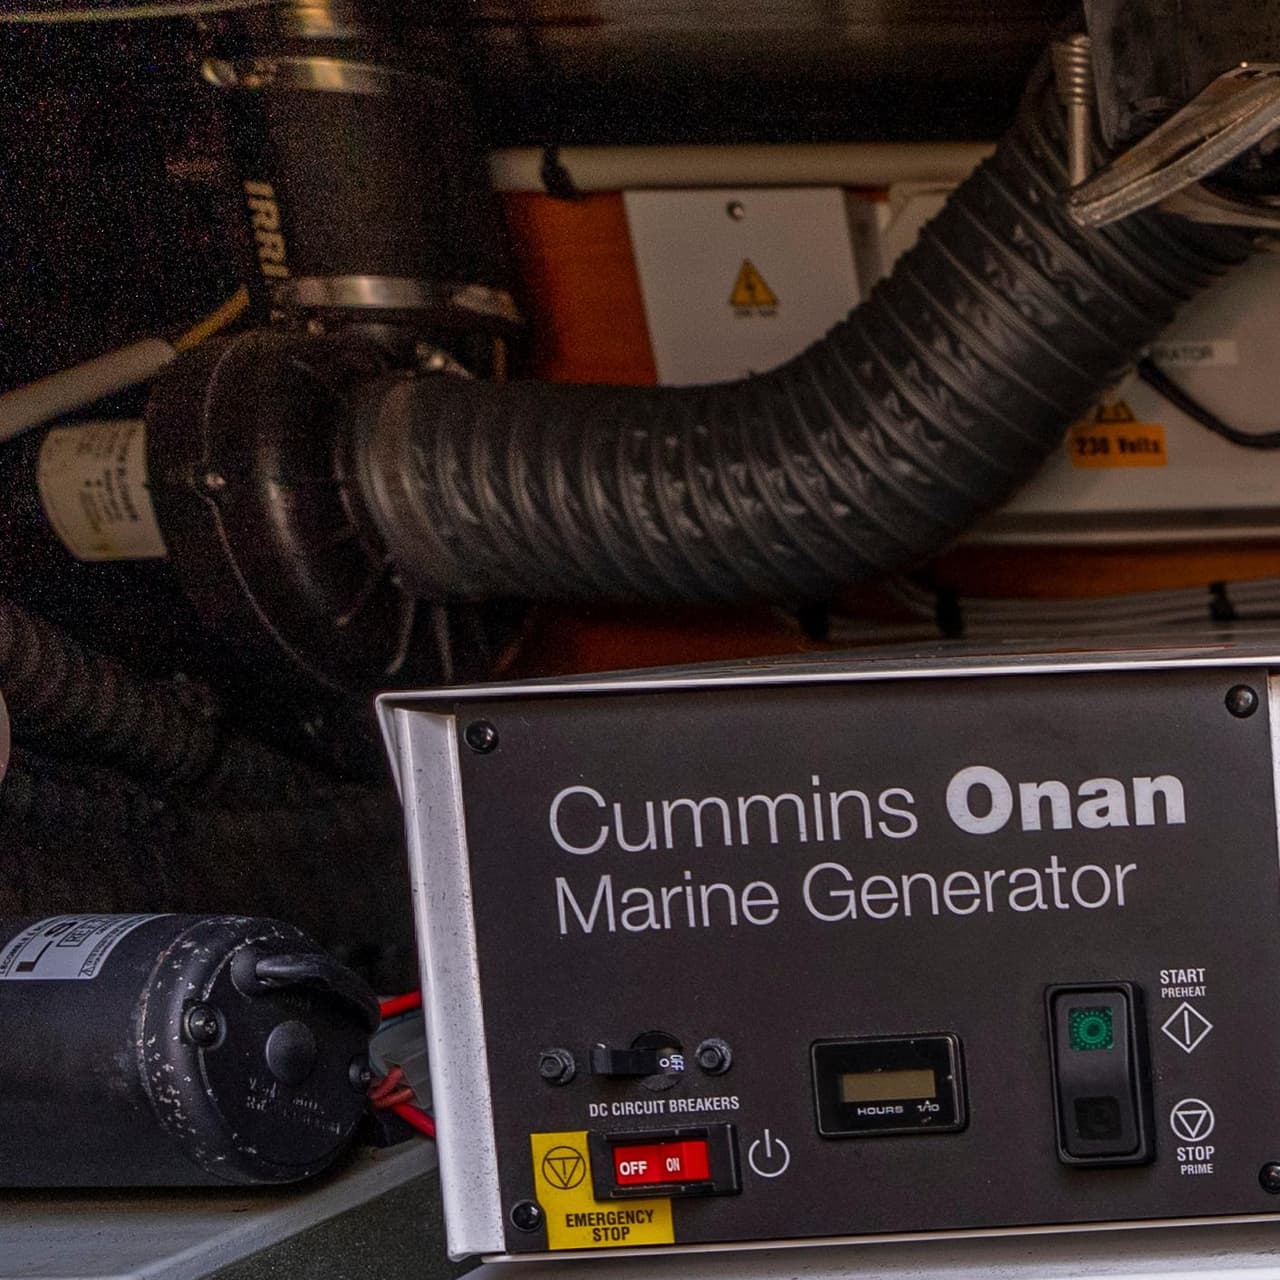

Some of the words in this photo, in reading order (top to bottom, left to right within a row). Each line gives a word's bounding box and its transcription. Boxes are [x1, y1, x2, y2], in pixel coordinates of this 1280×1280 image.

[549, 774, 918, 855] Cummins
[946, 766, 1186, 834] Onan
[555, 870, 779, 934] Marine
[803, 856, 1137, 921] Generator
[1160, 968, 1205, 984] START
[1161, 985, 1206, 998] PREHEAT
[589, 1102, 608, 1117] DC
[611, 1099, 665, 1116] CIRCUIT
[668, 1095, 739, 1113] BREAKERS
[857, 1105, 903, 1115] HOURS
[1177, 1145, 1214, 1161] STOP
[619, 1160, 647, 1175] OFF
[666, 1157, 680, 1172] ON
[1180, 1163, 1213, 1175] PRIME
[565, 1208, 655, 1229] EMERGENCY
[592, 1225, 630, 1242] STOP
